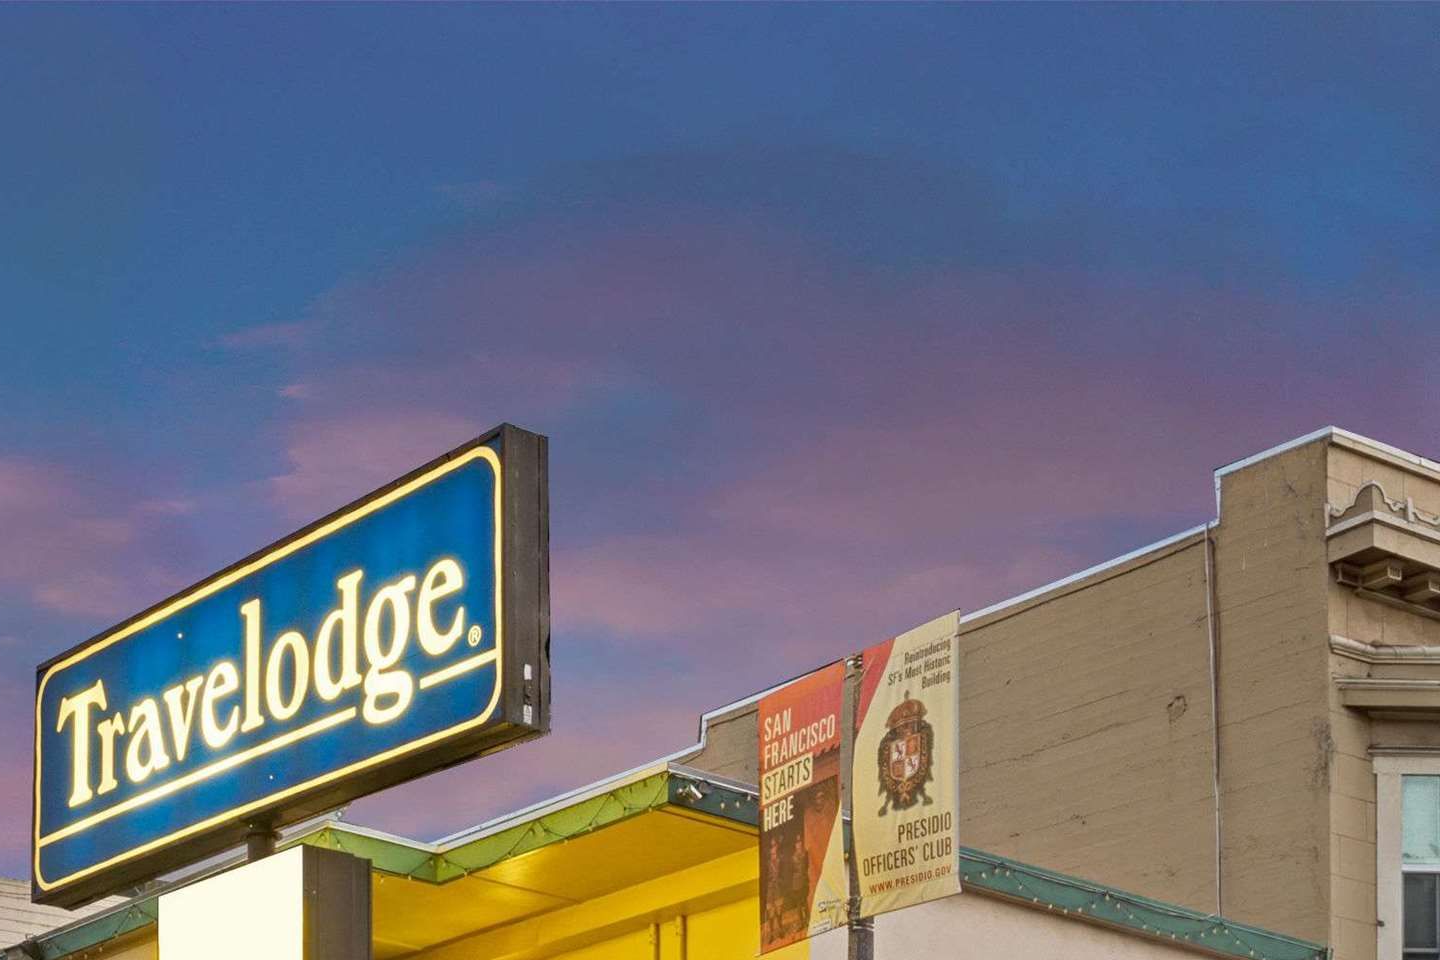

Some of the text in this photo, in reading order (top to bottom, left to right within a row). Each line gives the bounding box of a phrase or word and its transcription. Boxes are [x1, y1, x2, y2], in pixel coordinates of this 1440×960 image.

[57, 558, 466, 808] Travelodge
[922, 670, 951, 689] Building
[764, 707, 791, 742] SAN
[764, 713, 836, 769] FRANCISCO
[764, 759, 811, 800] STARTS
[763, 797, 795, 832] HERE
[897, 811, 952, 844] PRESIDIO
[863, 837, 952, 877] OFFICERS' CLUB
[869, 863, 952, 895] WWW.PRESIDIO.GOV
